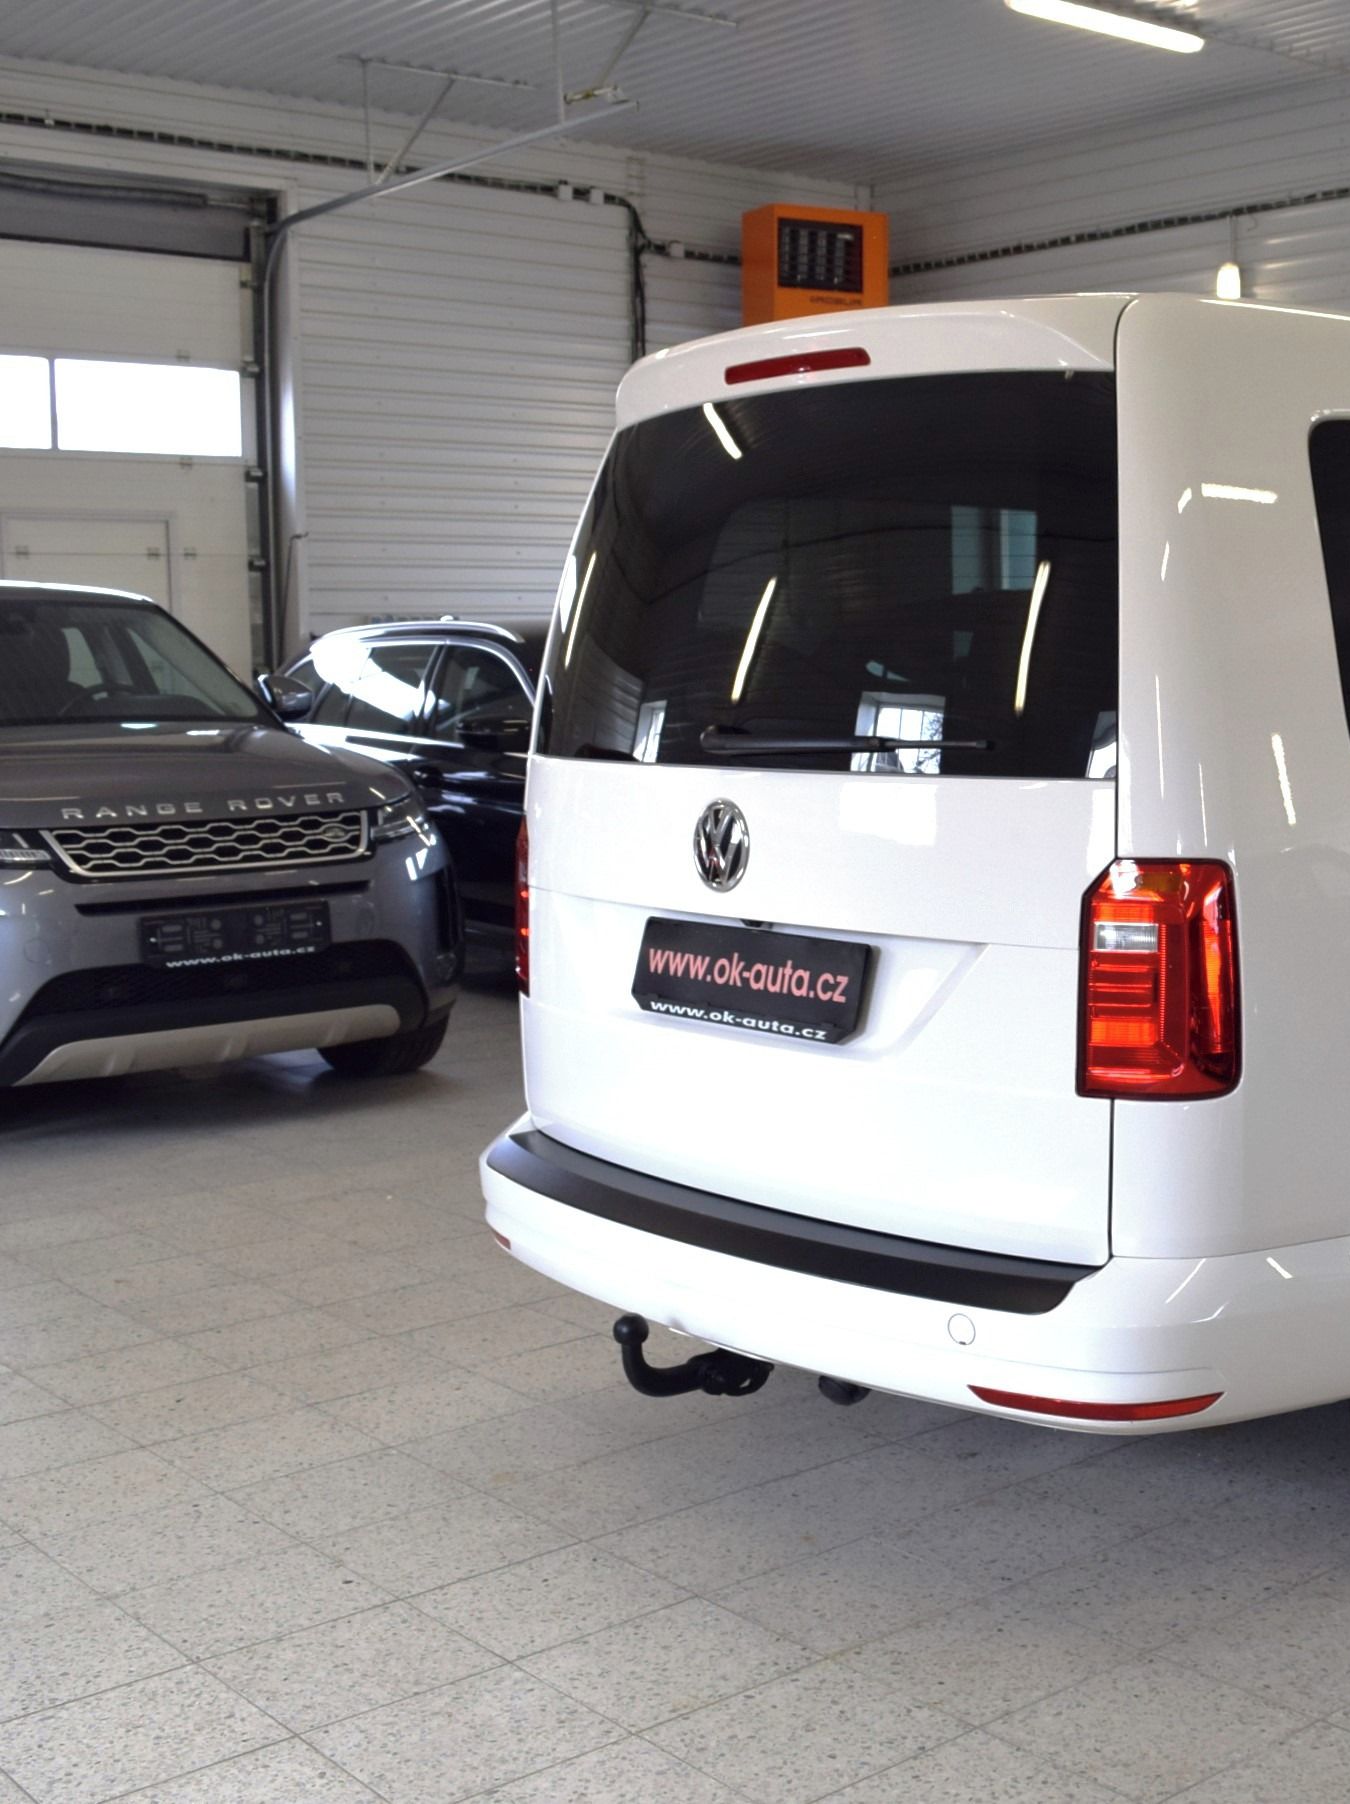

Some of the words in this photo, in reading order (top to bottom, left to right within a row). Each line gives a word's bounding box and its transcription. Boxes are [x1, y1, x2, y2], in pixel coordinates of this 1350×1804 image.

[61, 801, 204, 820] RANGE
[227, 792, 346, 812] ROVER
[648, 947, 850, 1004] www.ok-auta.cz
[649, 1000, 828, 1041] www.ok-auta.cz
